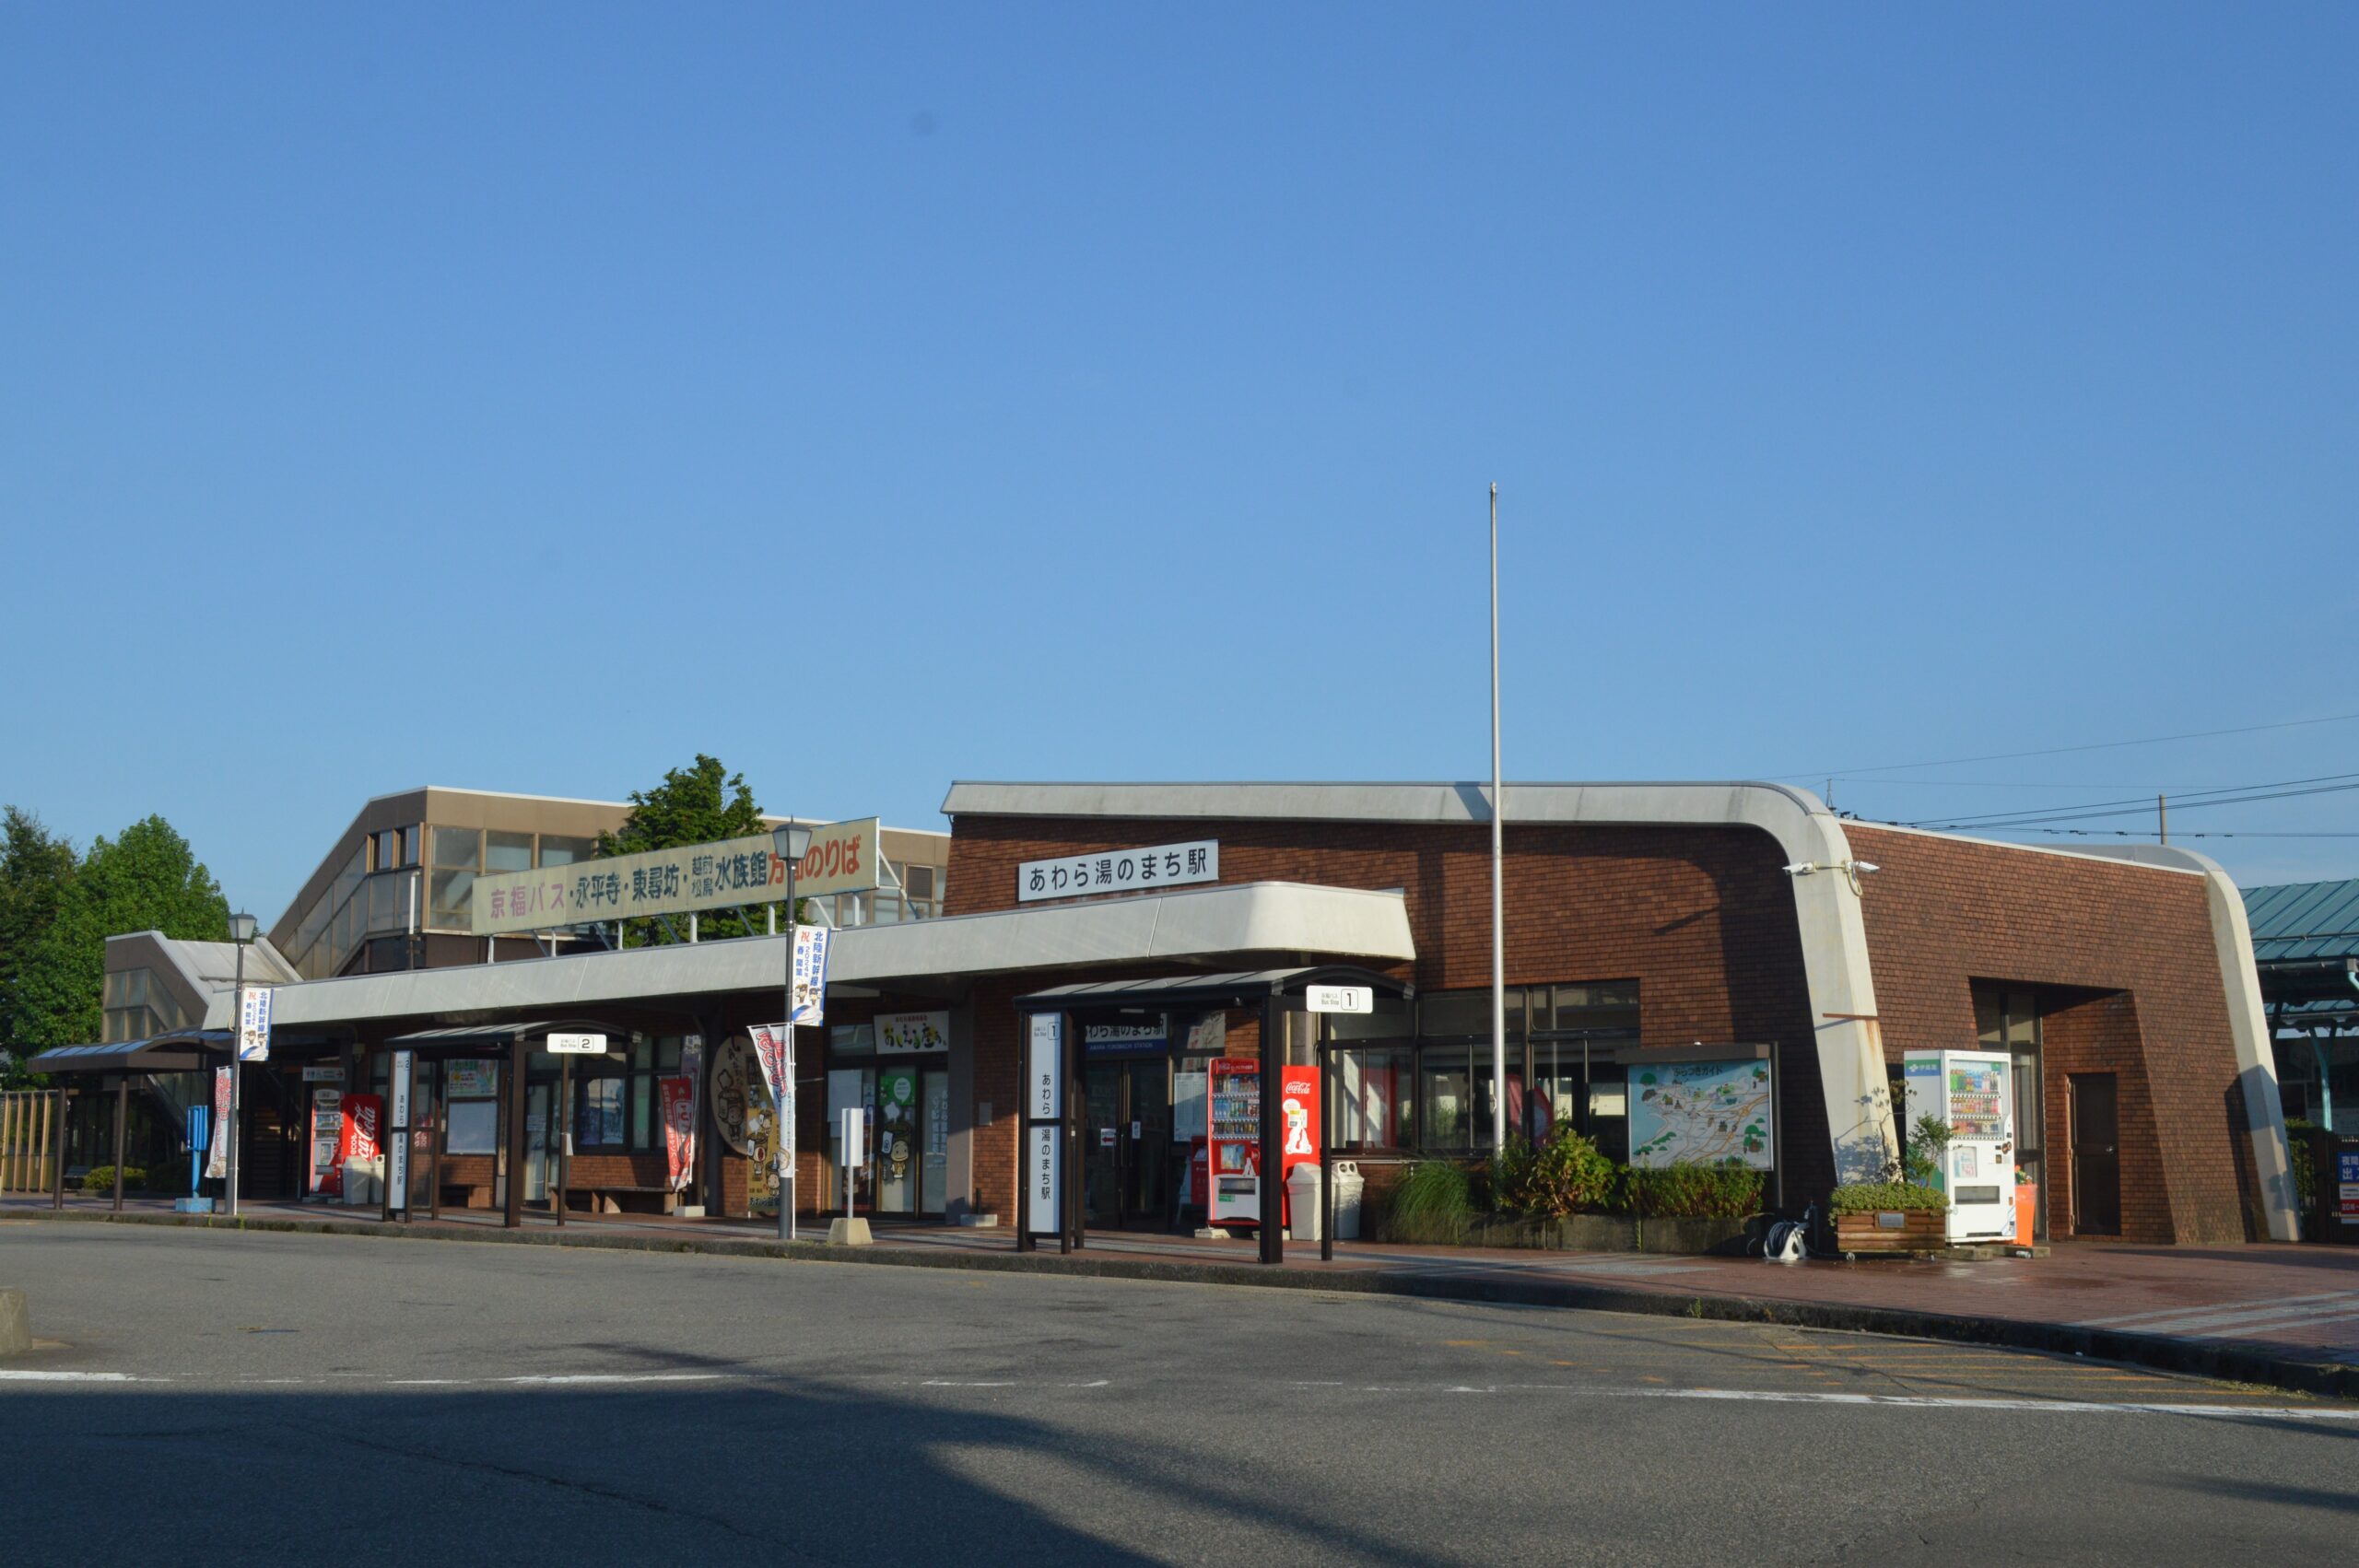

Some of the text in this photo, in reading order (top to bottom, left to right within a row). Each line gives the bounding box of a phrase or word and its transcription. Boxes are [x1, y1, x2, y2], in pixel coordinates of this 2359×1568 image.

[1029, 848, 1206, 892] あわら湯のまち駅
[810, 930, 824, 987] 北陸新幹線
[1346, 992, 1352, 1007] 1
[581, 1038, 591, 1048] 2
[1051, 1024, 1056, 1037] 1
[405, 1059, 410, 1069] 2
[1042, 1074, 1051, 1115] あわら
[1040, 1129, 1050, 1199] 湯のまち駅
